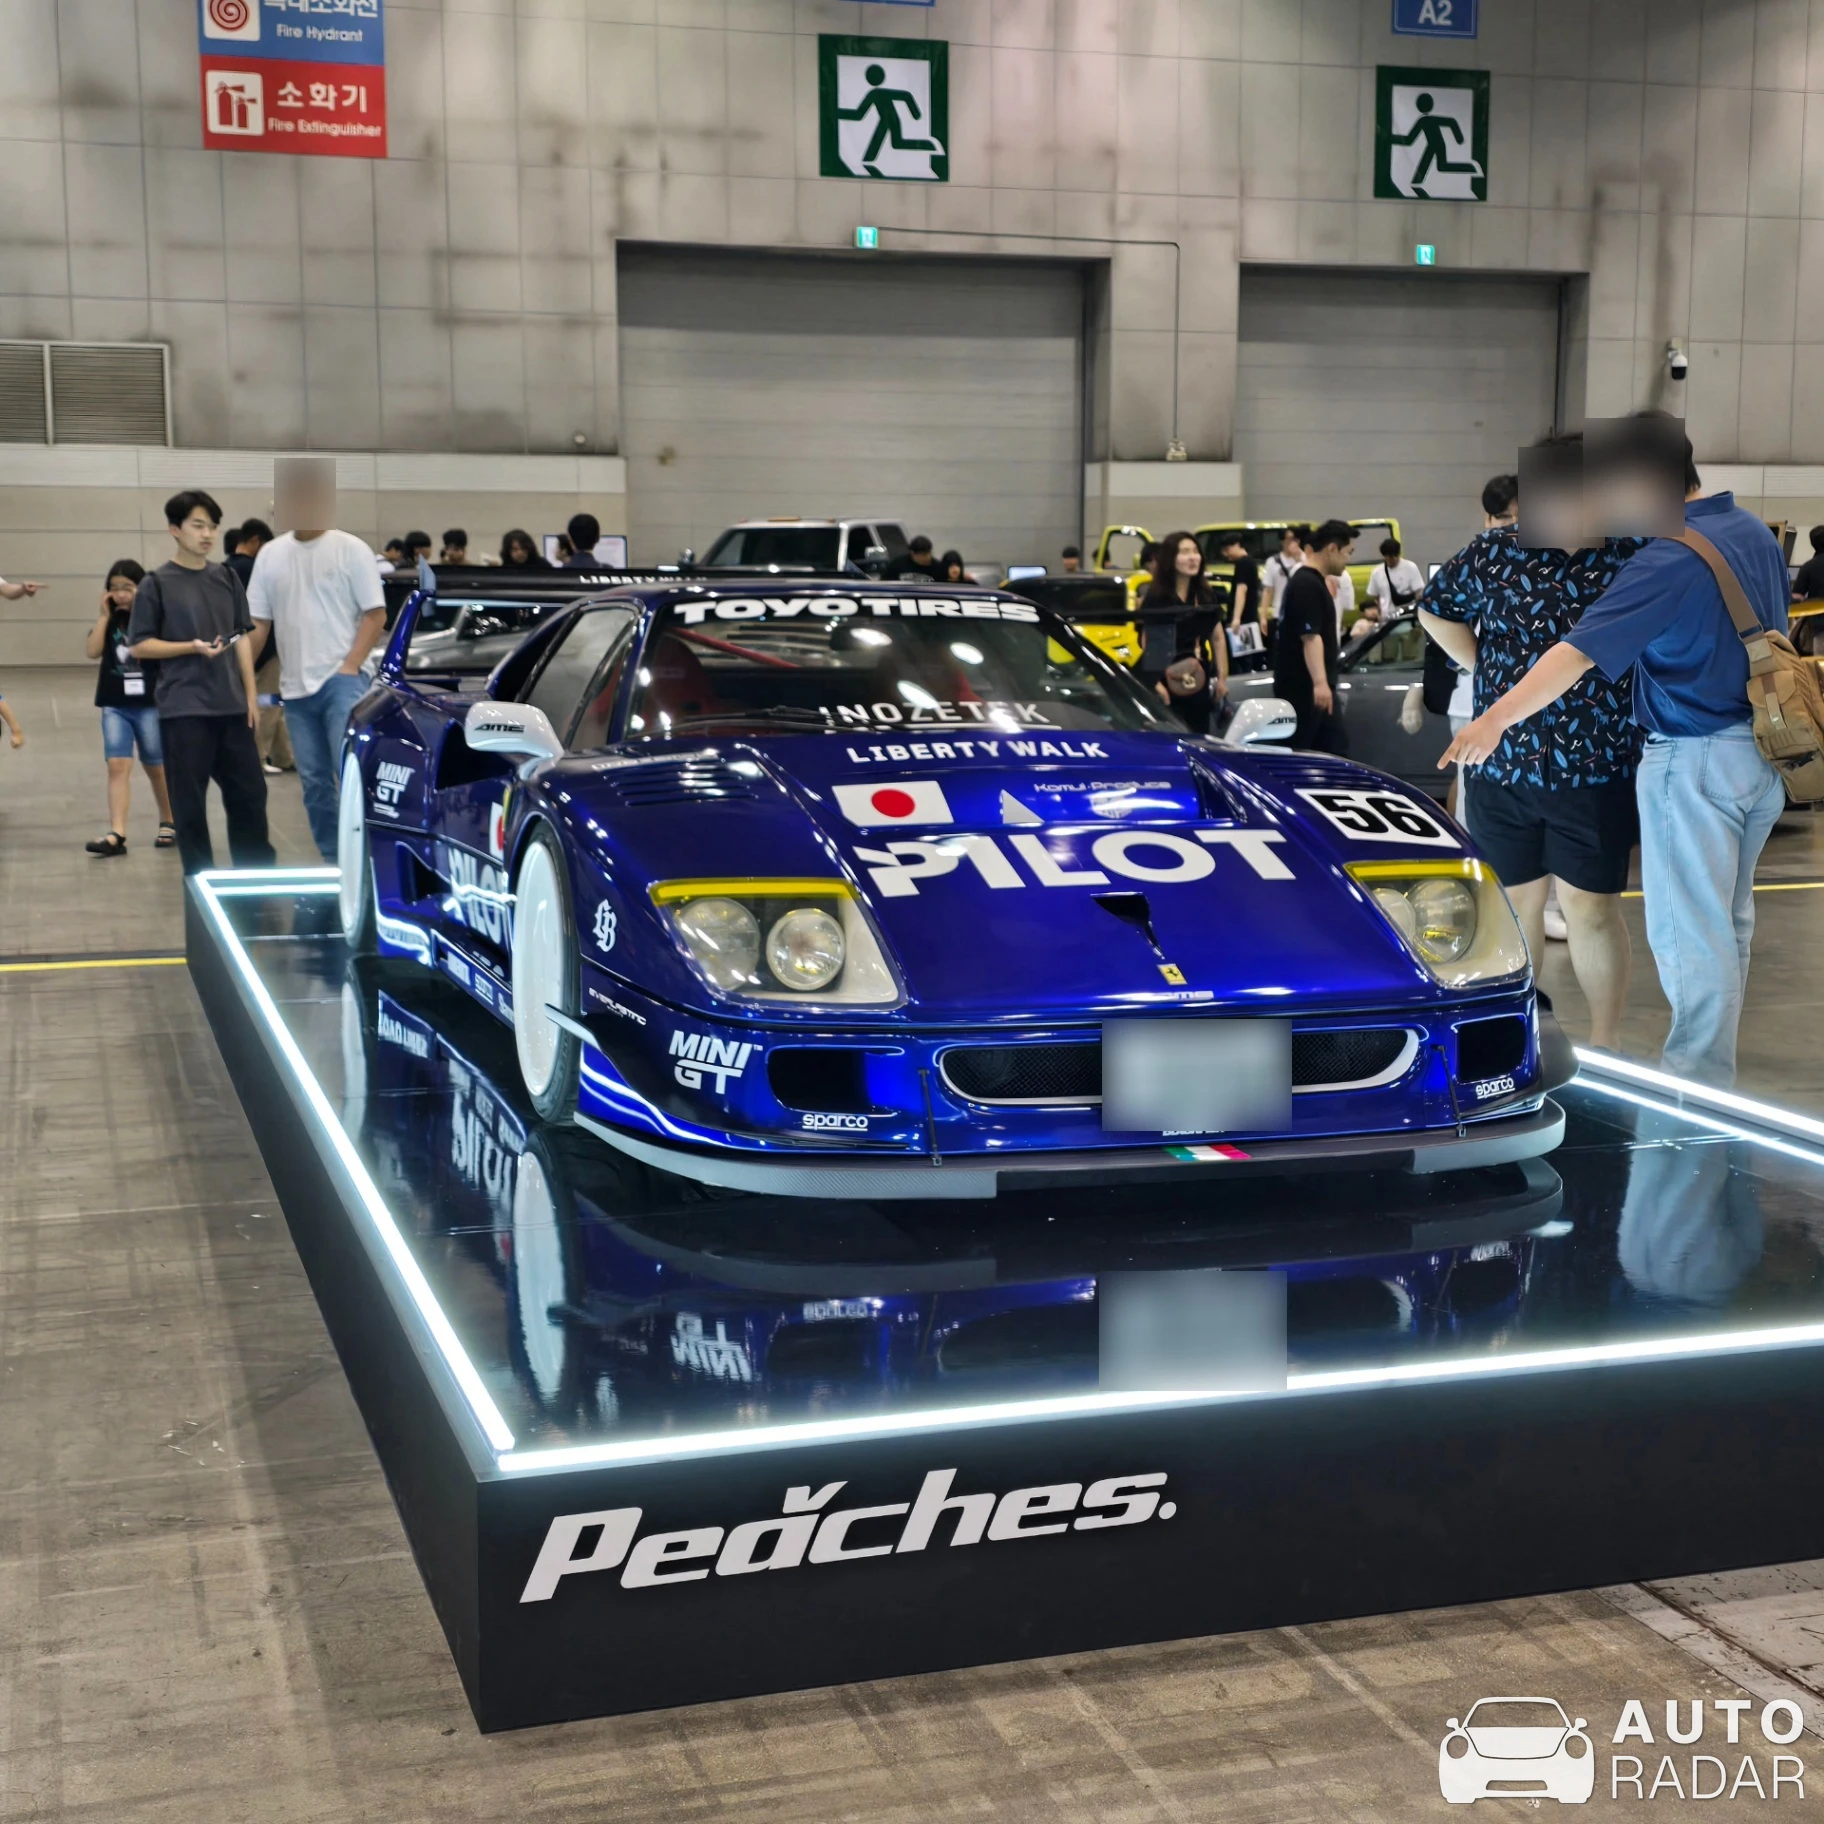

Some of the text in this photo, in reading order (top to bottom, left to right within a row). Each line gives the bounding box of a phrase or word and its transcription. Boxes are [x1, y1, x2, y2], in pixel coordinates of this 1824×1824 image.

[1418, 0, 1452, 25] A2
[276, 23, 363, 42] Fire Hydrant
[277, 81, 367, 113] 소화기
[268, 117, 382, 137] Fire Extinguisher
[674, 598, 1041, 624] TOYO TIRES
[847, 741, 1109, 763] LIBERTY WALK
[376, 761, 412, 786] MINI
[377, 780, 406, 804] GT
[1308, 795, 1440, 838] 56
[852, 830, 1297, 898] PILOT
[669, 1030, 753, 1068] MINI
[674, 1059, 743, 1094] GT
[1475, 1077, 1516, 1099] sparco
[803, 1113, 868, 1130] sparco
